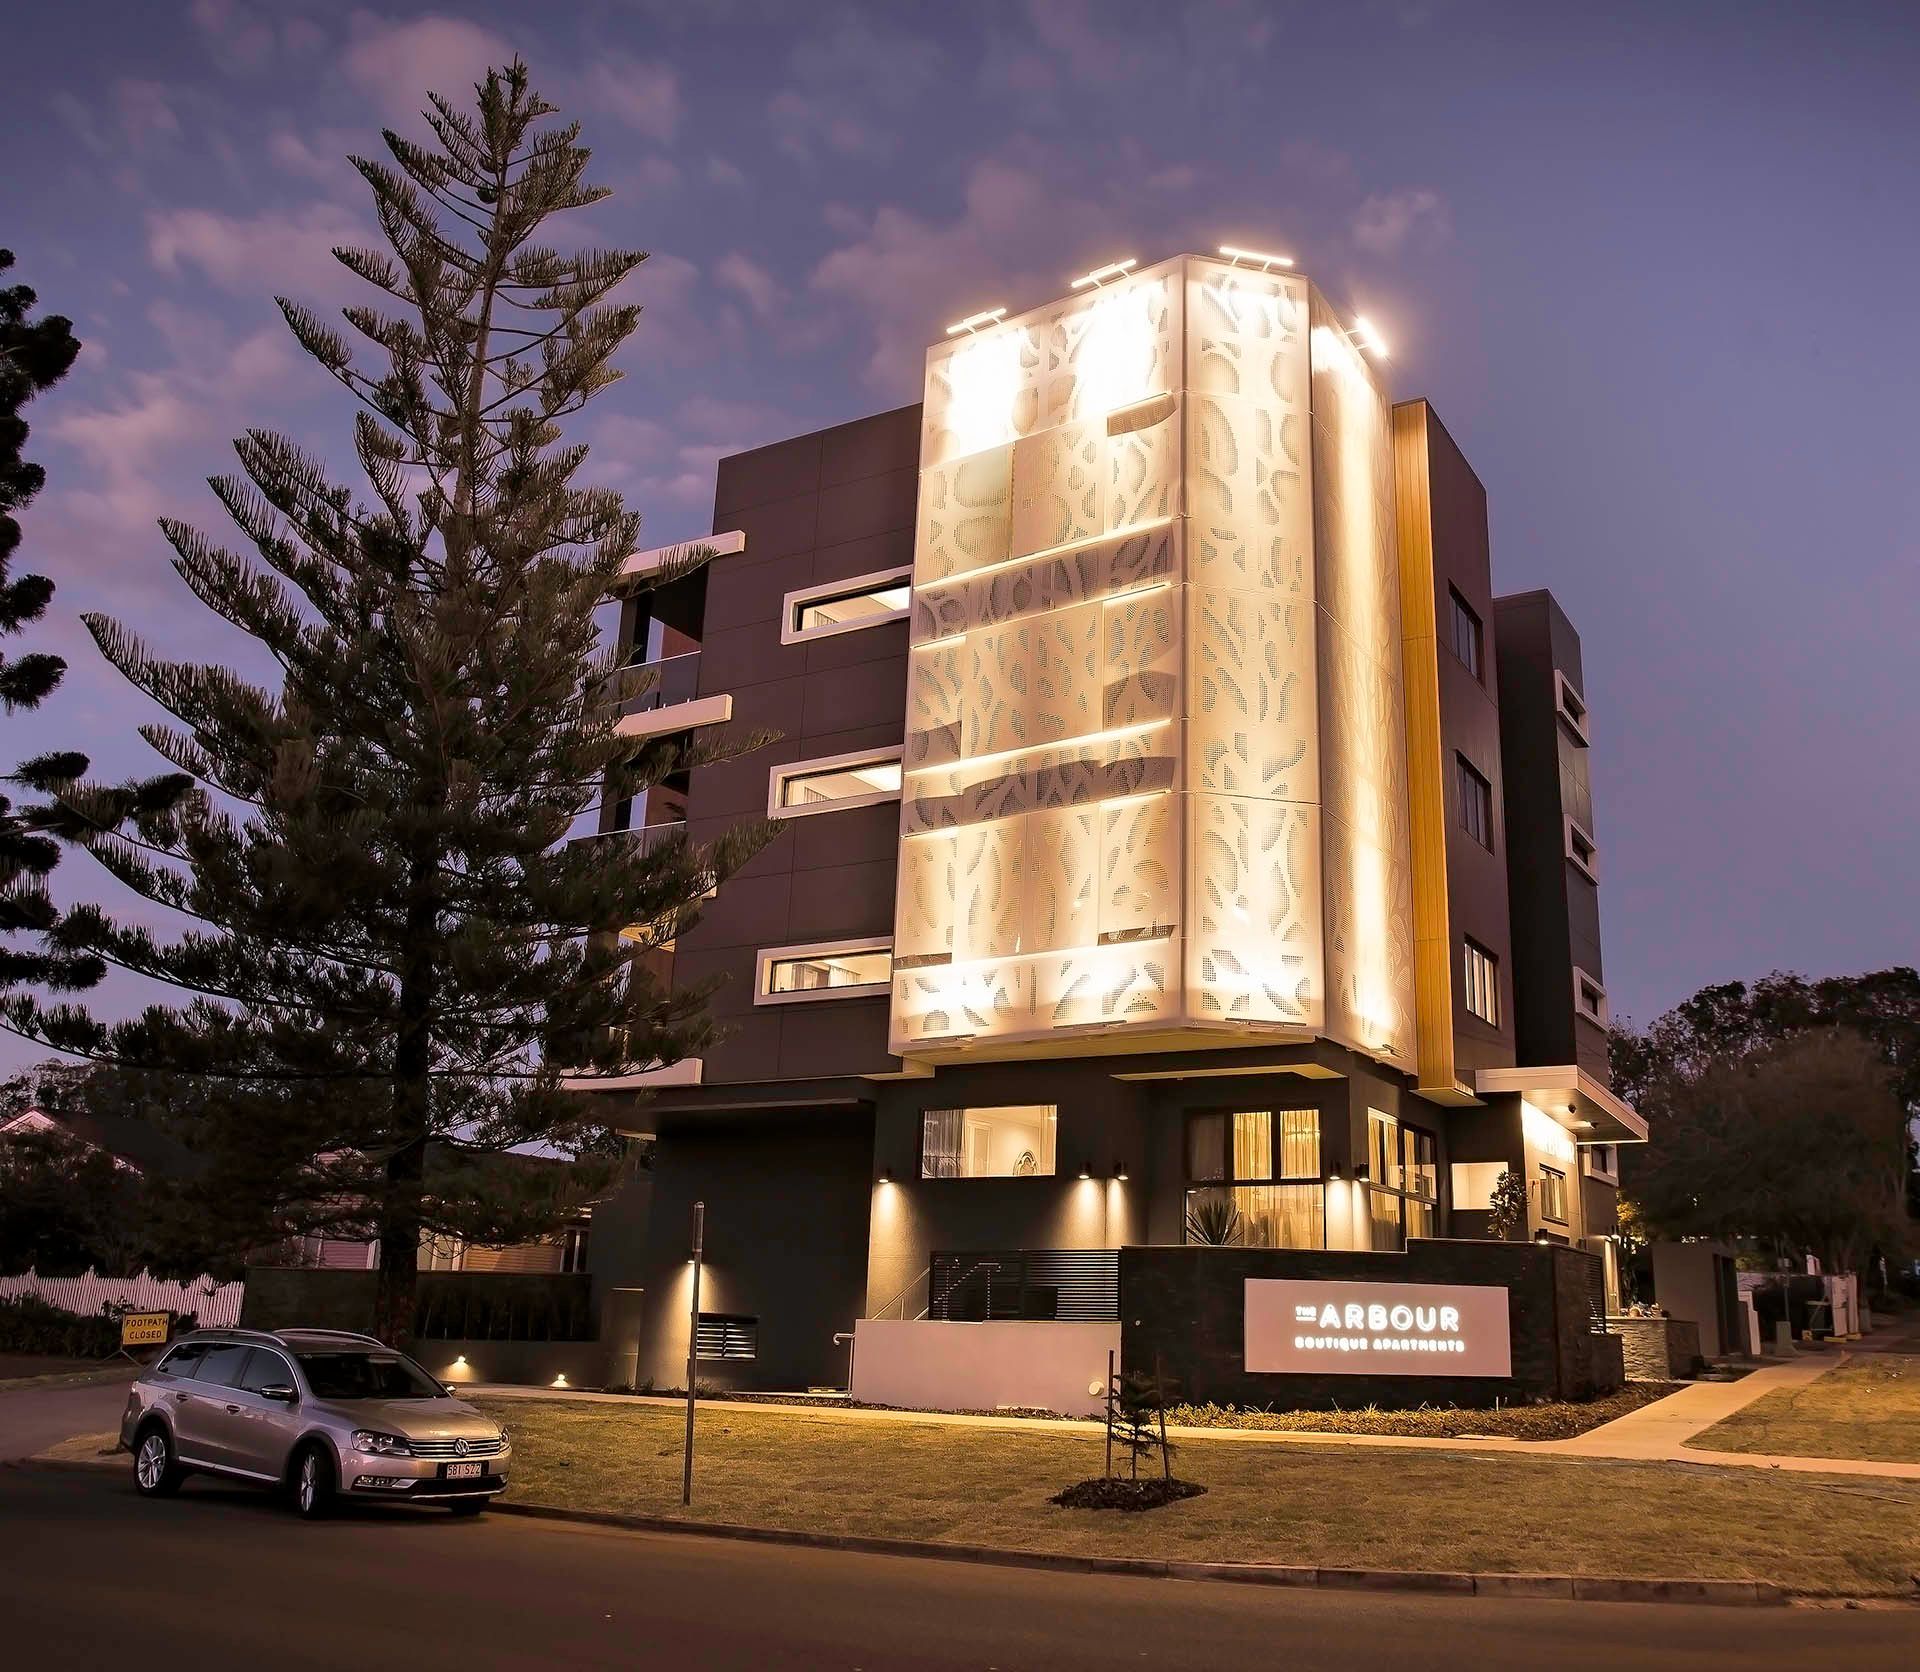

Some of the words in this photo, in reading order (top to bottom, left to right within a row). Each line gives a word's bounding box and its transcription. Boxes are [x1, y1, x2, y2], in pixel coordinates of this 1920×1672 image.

[126, 1318, 168, 1327] FOOTPATH
[1295, 1306, 1316, 1316] THE
[1319, 1304, 1459, 1331] ARBOUR
[129, 1330, 162, 1339] CLOSED
[1294, 1336, 1368, 1351] BOUTIQUE
[1373, 1338, 1465, 1352] APARTMENTS
[448, 1465, 461, 1475] 581
